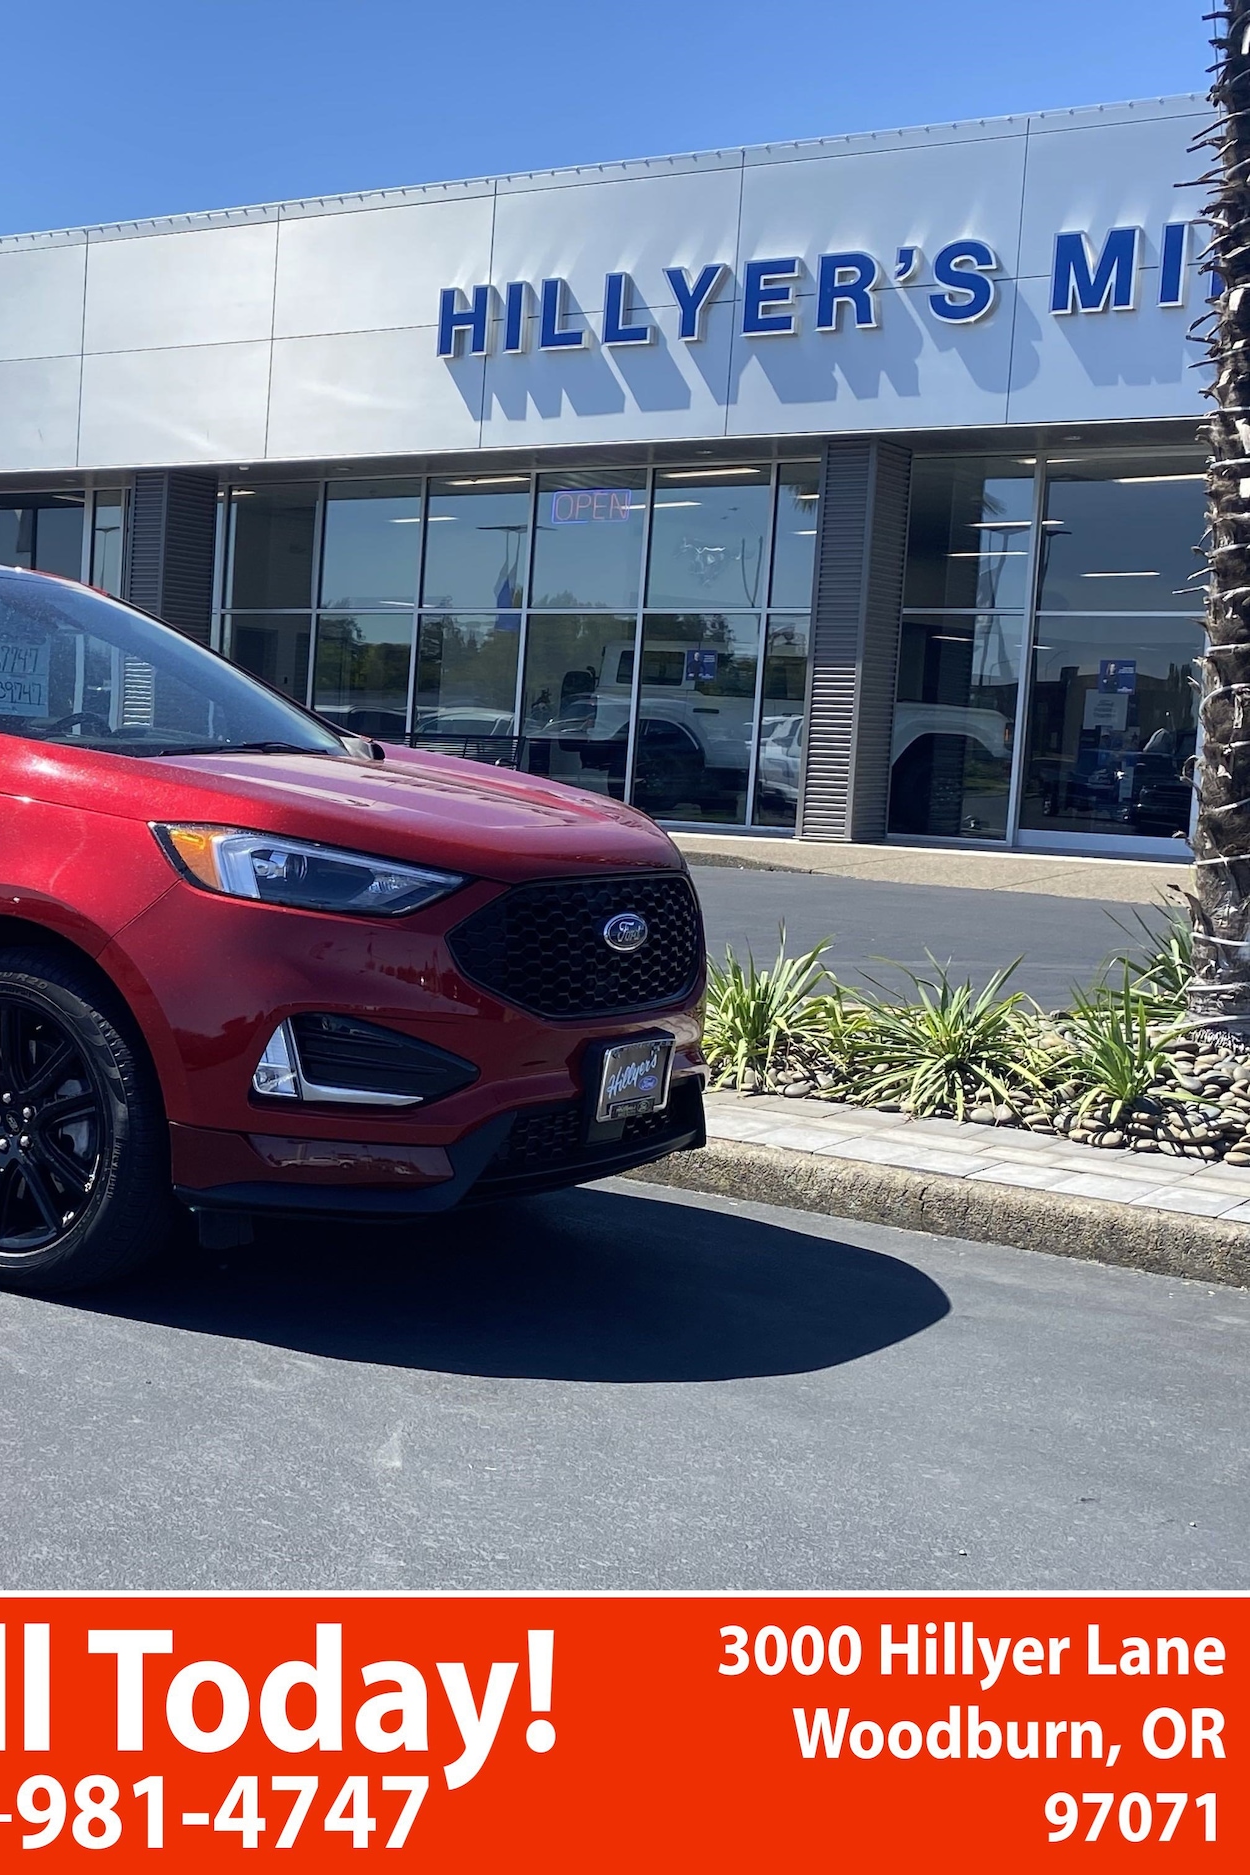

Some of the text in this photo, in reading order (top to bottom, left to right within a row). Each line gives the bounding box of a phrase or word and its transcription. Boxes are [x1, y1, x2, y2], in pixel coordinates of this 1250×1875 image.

[436, 221, 1227, 360] HILLYER'S MI
[555, 492, 629, 521] OPEN
[617, 921, 643, 943] Ford
[606, 1050, 658, 1099] Hillyer's
